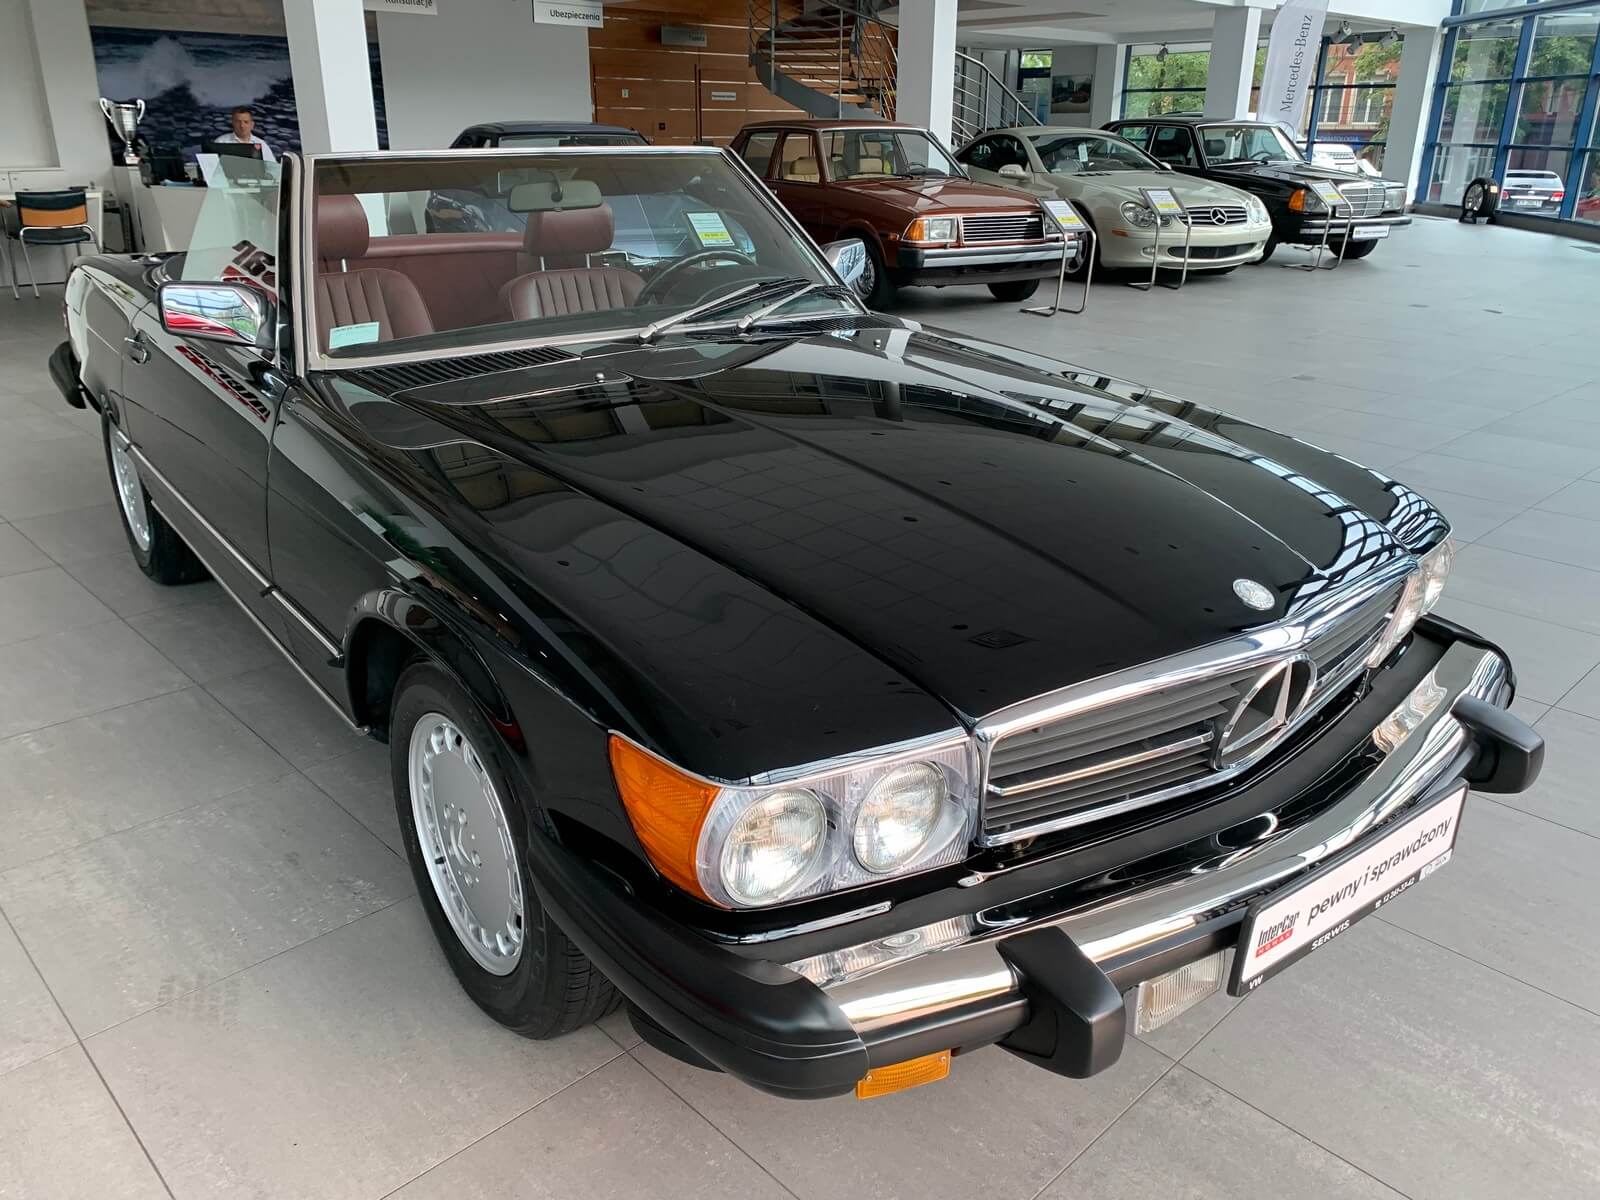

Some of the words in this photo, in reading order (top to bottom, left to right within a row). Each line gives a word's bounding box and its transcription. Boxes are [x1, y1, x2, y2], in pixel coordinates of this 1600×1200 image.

[549, 9, 600, 21] Ubezpieczenia
[1280, 14, 1313, 113] Mercedes-Benz
[1306, 875, 1362, 926] pewny
[1363, 865, 1371, 887] i
[1370, 816, 1452, 882] sprawdzony
[1249, 974, 1263, 990] VW
[1311, 919, 1350, 951] SERWIS
[1258, 911, 1300, 948] InterCar
